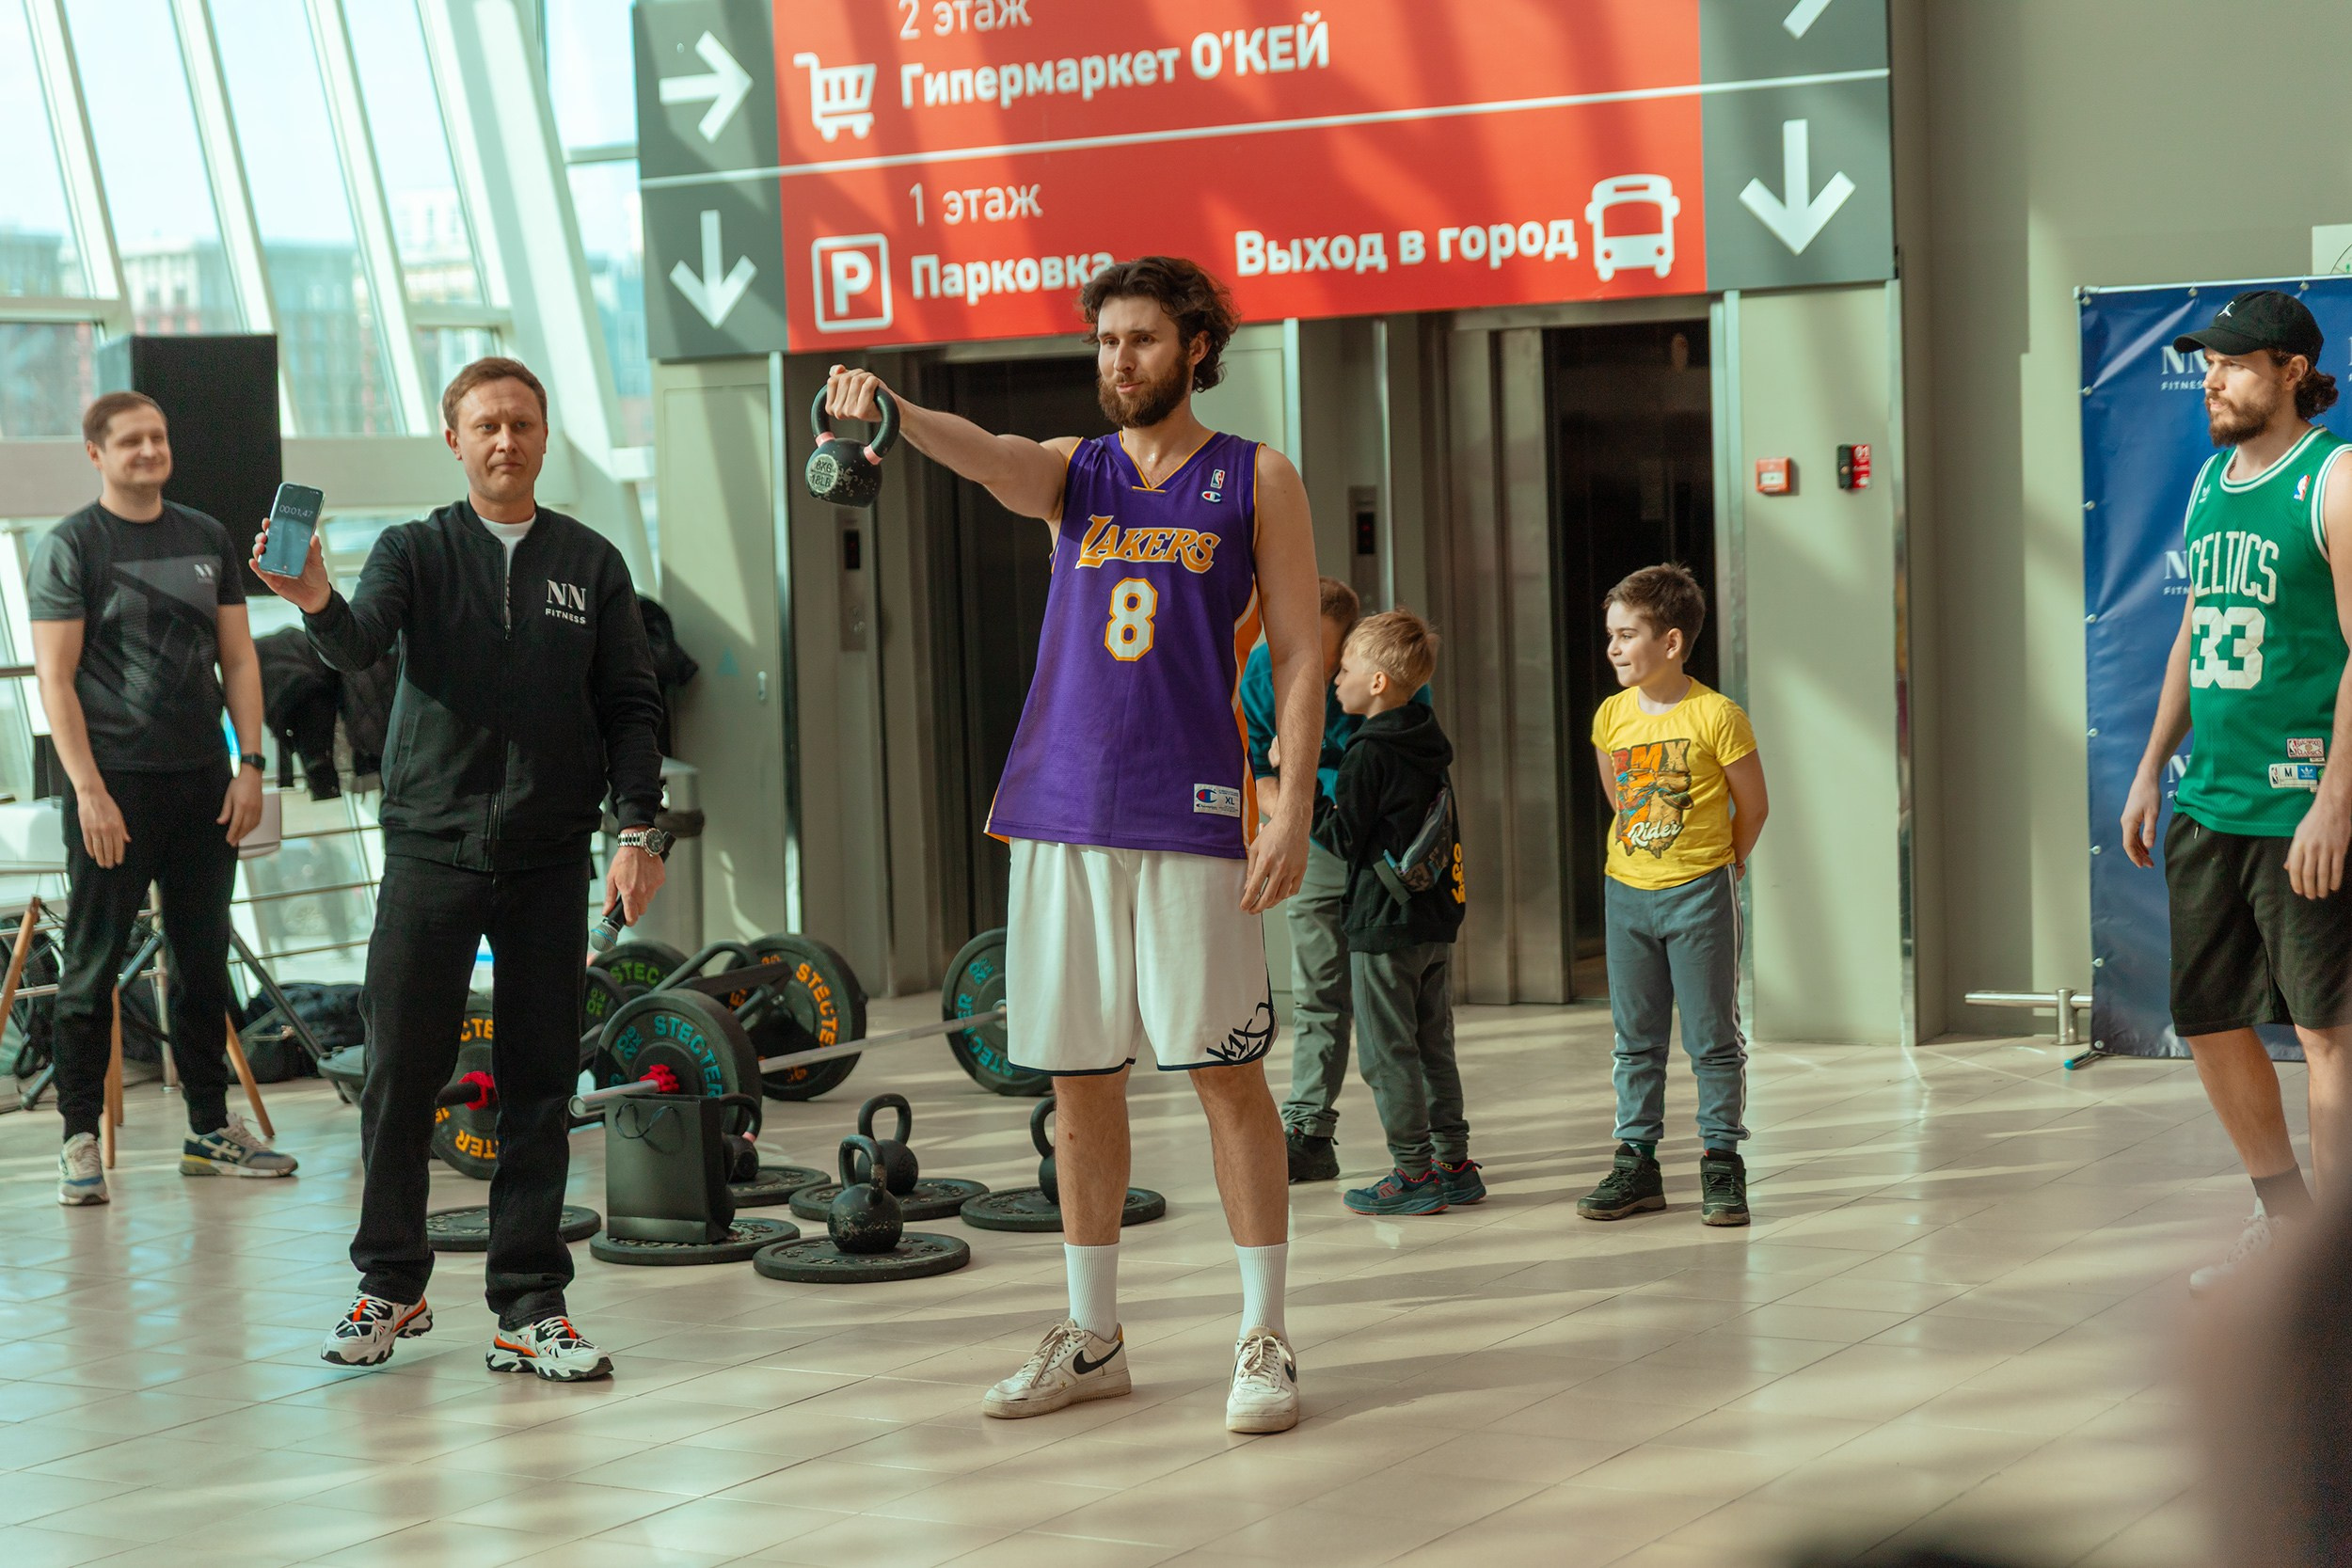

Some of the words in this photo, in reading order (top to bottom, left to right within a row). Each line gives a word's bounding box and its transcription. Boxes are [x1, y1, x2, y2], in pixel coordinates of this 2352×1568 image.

[898, 0, 921, 40] 2
[932, 0, 1033, 32] этаж
[900, 48, 1181, 109] Гипермаркет
[1190, 10, 1330, 79] О'КЕЙ
[909, 182, 925, 227] 1
[943, 183, 1043, 225] этаж
[1235, 230, 1389, 277] Выход
[1398, 230, 1426, 264] в
[1438, 218, 1579, 270] город
[2160, 380, 2204, 391] FITNES
[1074, 514, 1221, 574] LAKERS
[2164, 549, 2188, 579] N
[2188, 531, 2280, 604] CELTICS
[547, 578, 586, 611] NN
[2164, 585, 2190, 595] FITN
[545, 608, 586, 625] FITNESS
[1104, 577, 1159, 662] 8
[2190, 606, 2265, 689] 33
[1612, 739, 1691, 775] BMX
[2168, 754, 2191, 783] N
[2284, 767, 2293, 777] M
[1225, 796, 1235, 805] XL
[1628, 820, 1683, 847] Rider
[610, 962, 667, 984] STEC
[796, 962, 839, 1049] STECTE
[454, 1130, 499, 1160] TER
